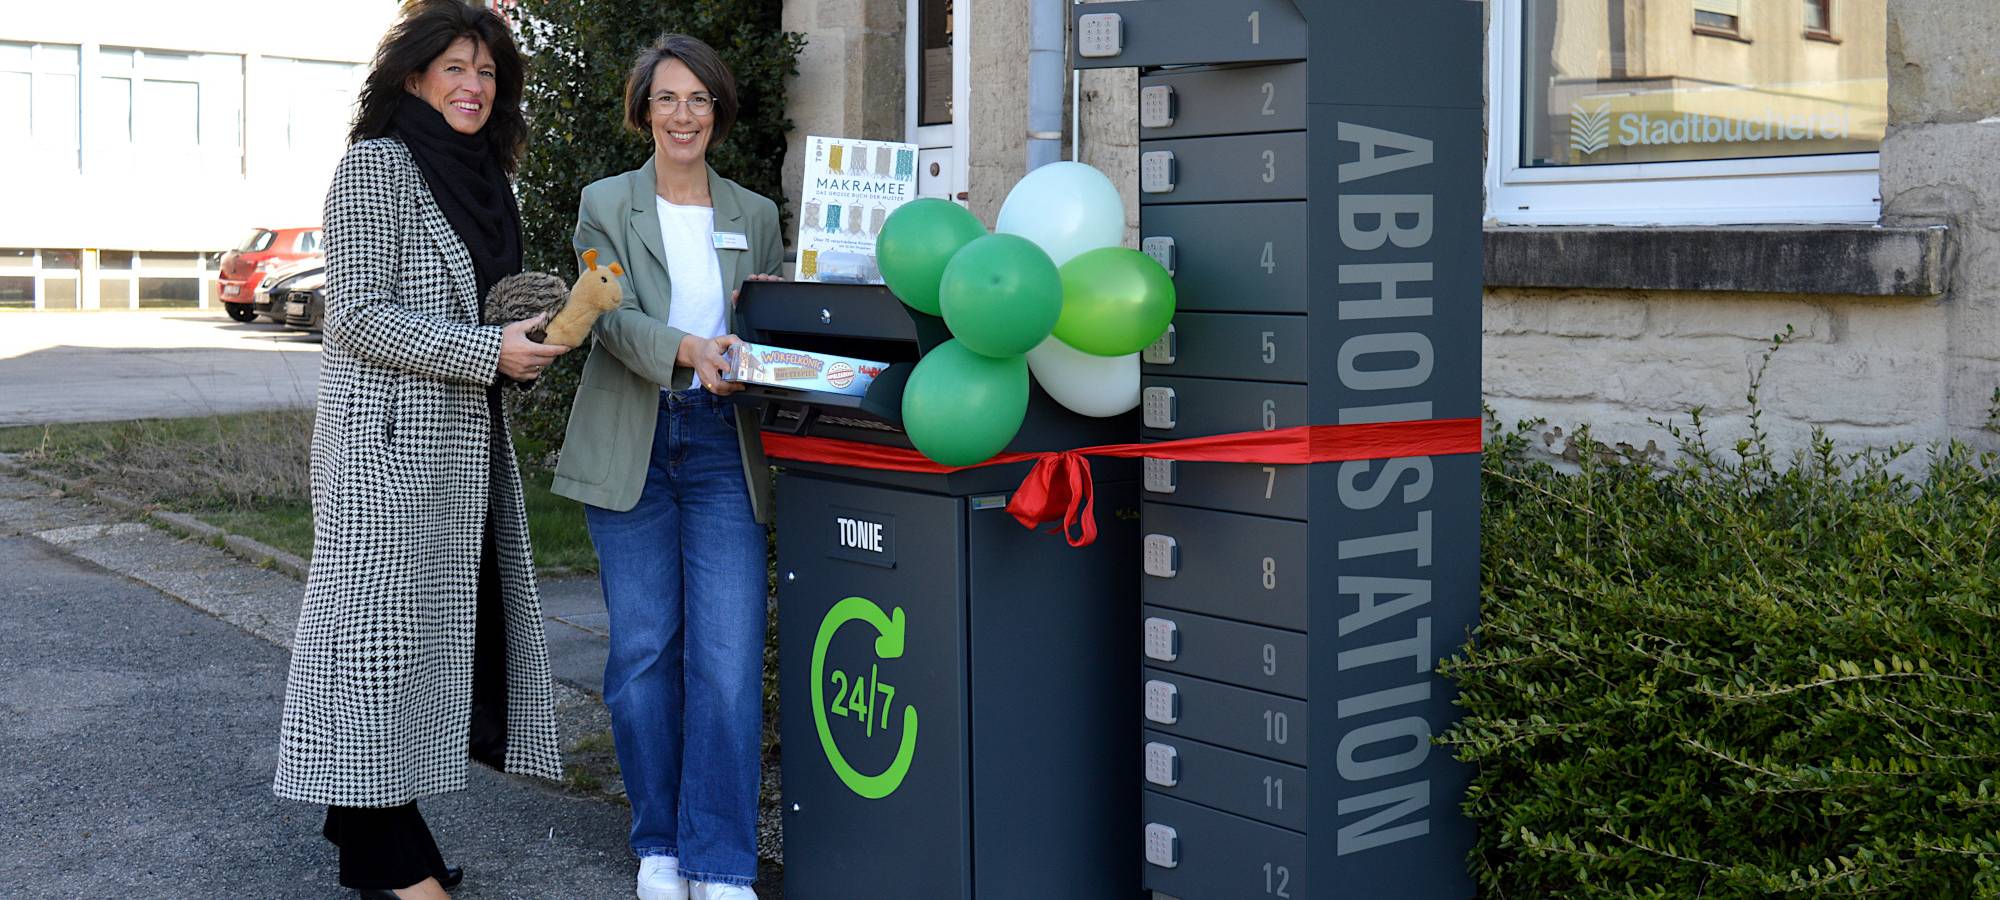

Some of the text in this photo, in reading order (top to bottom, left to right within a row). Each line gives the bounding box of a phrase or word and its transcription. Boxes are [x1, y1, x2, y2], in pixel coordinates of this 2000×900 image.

[1247, 11, 1260, 44] 1
[1261, 82, 1275, 116] 2
[1261, 149, 1275, 183] 3
[816, 177, 905, 195] MAKRAMEE
[1260, 241, 1276, 274] 4
[1262, 331, 1276, 364] 5
[1262, 399, 1276, 431] 6
[1262, 467, 1276, 499] 7
[837, 517, 883, 552] TONIE
[1262, 557, 1276, 590] 8
[1262, 643, 1276, 676] 9
[831, 664, 895, 737] 24/7
[1263, 709, 1288, 745] 10
[1263, 775, 1283, 810] 11
[1263, 862, 1290, 899] 12
